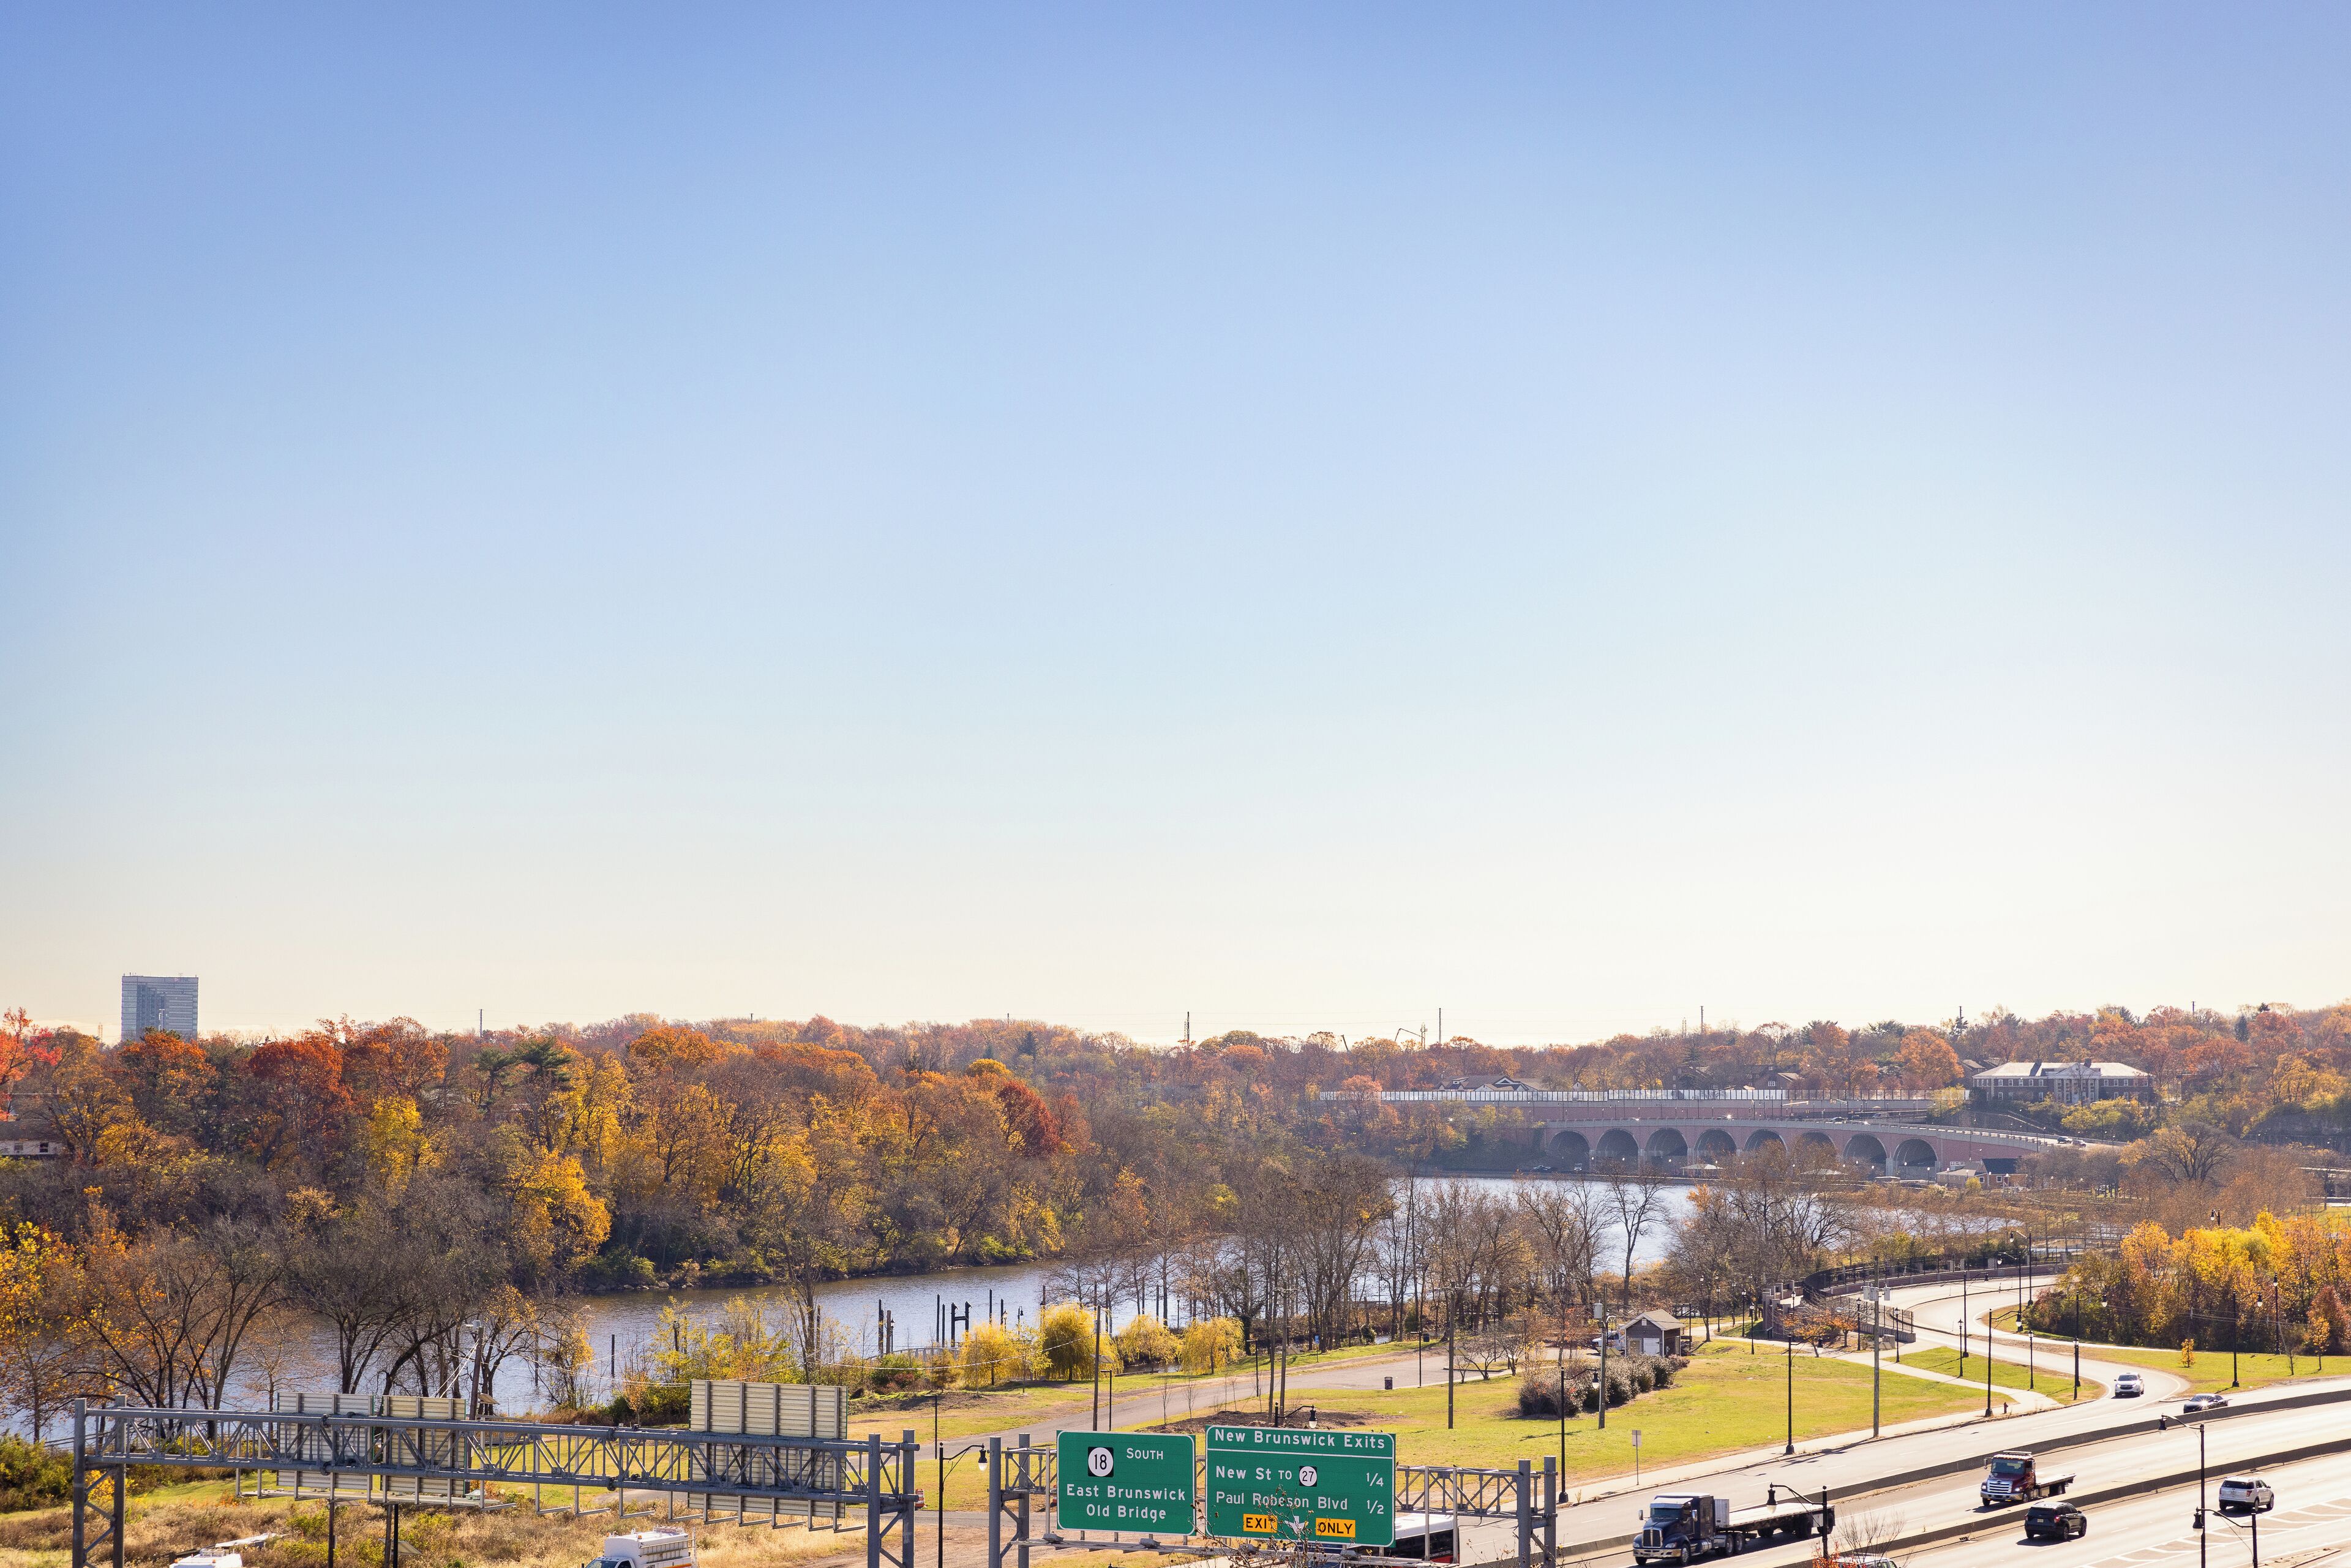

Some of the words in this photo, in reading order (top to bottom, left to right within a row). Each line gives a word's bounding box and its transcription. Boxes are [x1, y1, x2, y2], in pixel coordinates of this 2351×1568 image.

[1215, 1428, 1246, 1442] New
[1254, 1430, 1335, 1447] Brunswick
[1344, 1435, 1385, 1449] Exits
[1094, 1454, 1107, 1470] 18
[1126, 1447, 1164, 1460] SOUTH
[1215, 1465, 1247, 1479] New
[1255, 1467, 1272, 1480] St
[1278, 1470, 1292, 1480] TO
[1302, 1471, 1314, 1482] 27
[1067, 1484, 1099, 1497] East
[1107, 1485, 1185, 1501] Brunswick
[1216, 1491, 1244, 1504] Paul
[1253, 1493, 1309, 1508] Robeson
[1318, 1496, 1348, 1510] Blvd
[1086, 1504, 1109, 1517] Old
[1117, 1506, 1166, 1523] Bridge
[1318, 1521, 1353, 1534] ONLY
